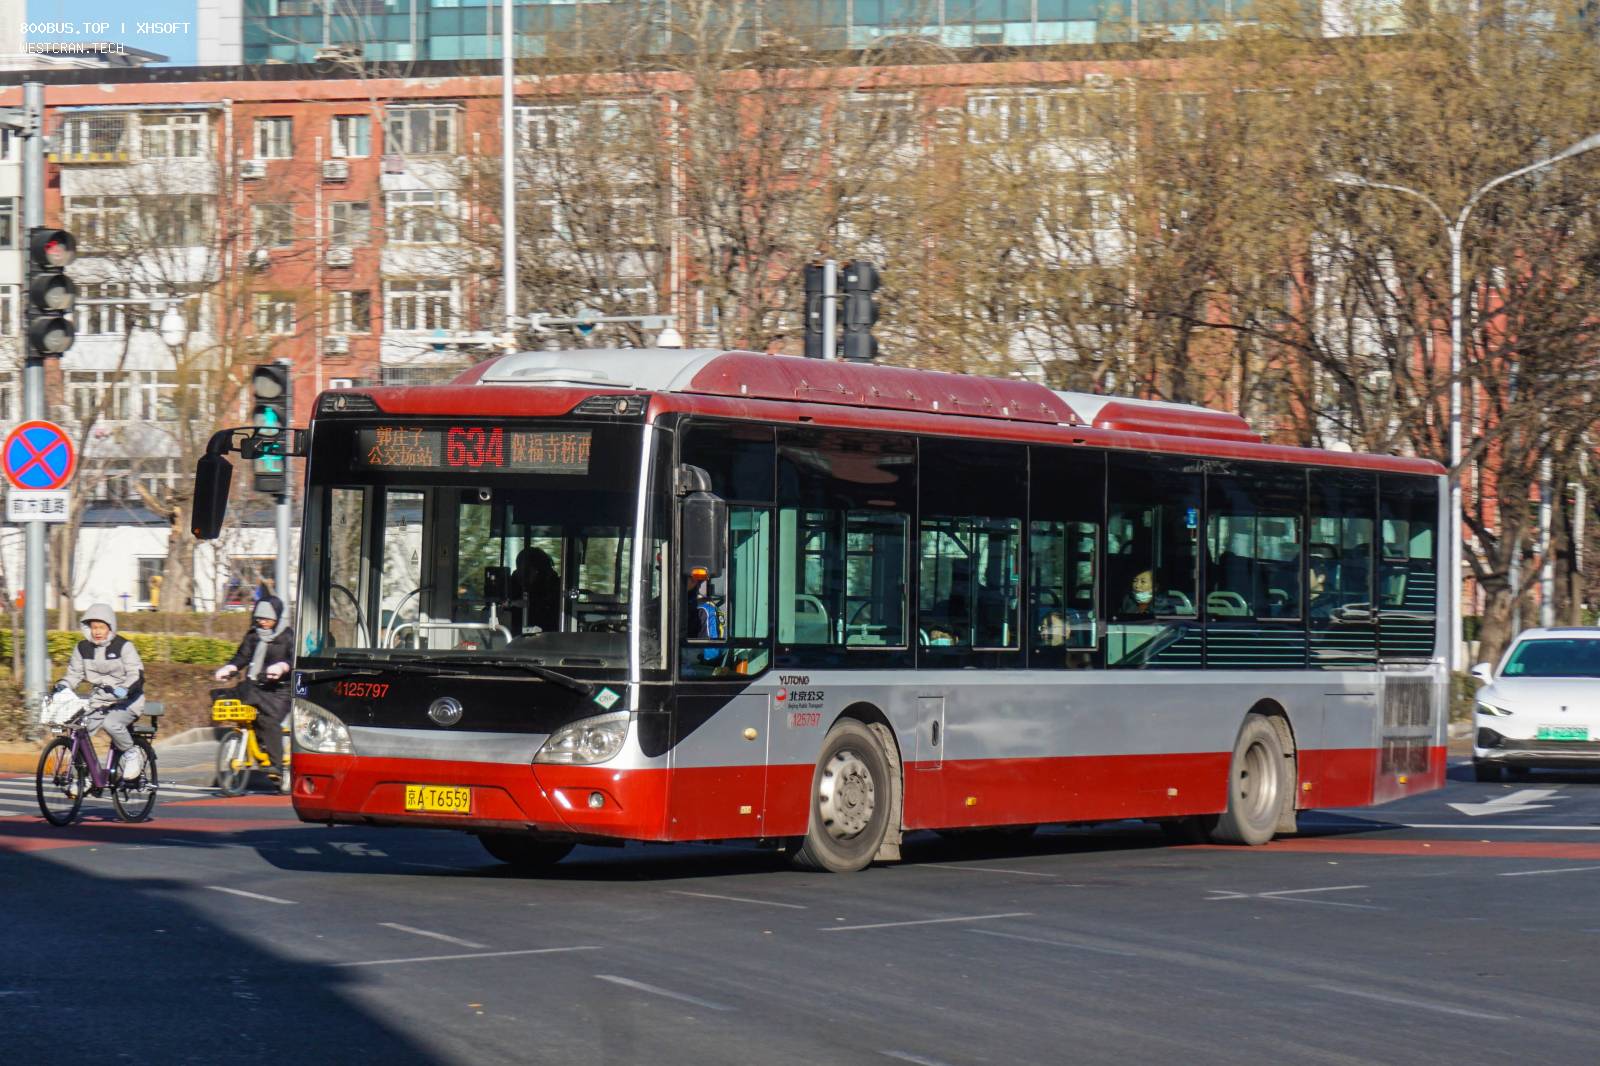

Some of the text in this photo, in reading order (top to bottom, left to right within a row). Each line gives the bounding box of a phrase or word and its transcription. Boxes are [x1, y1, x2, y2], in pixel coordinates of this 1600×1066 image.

[376, 426, 424, 447] 郭庄子
[448, 427, 504, 467] 634
[368, 446, 433, 467] 公交场站
[789, 690, 825, 701] 北京公交
